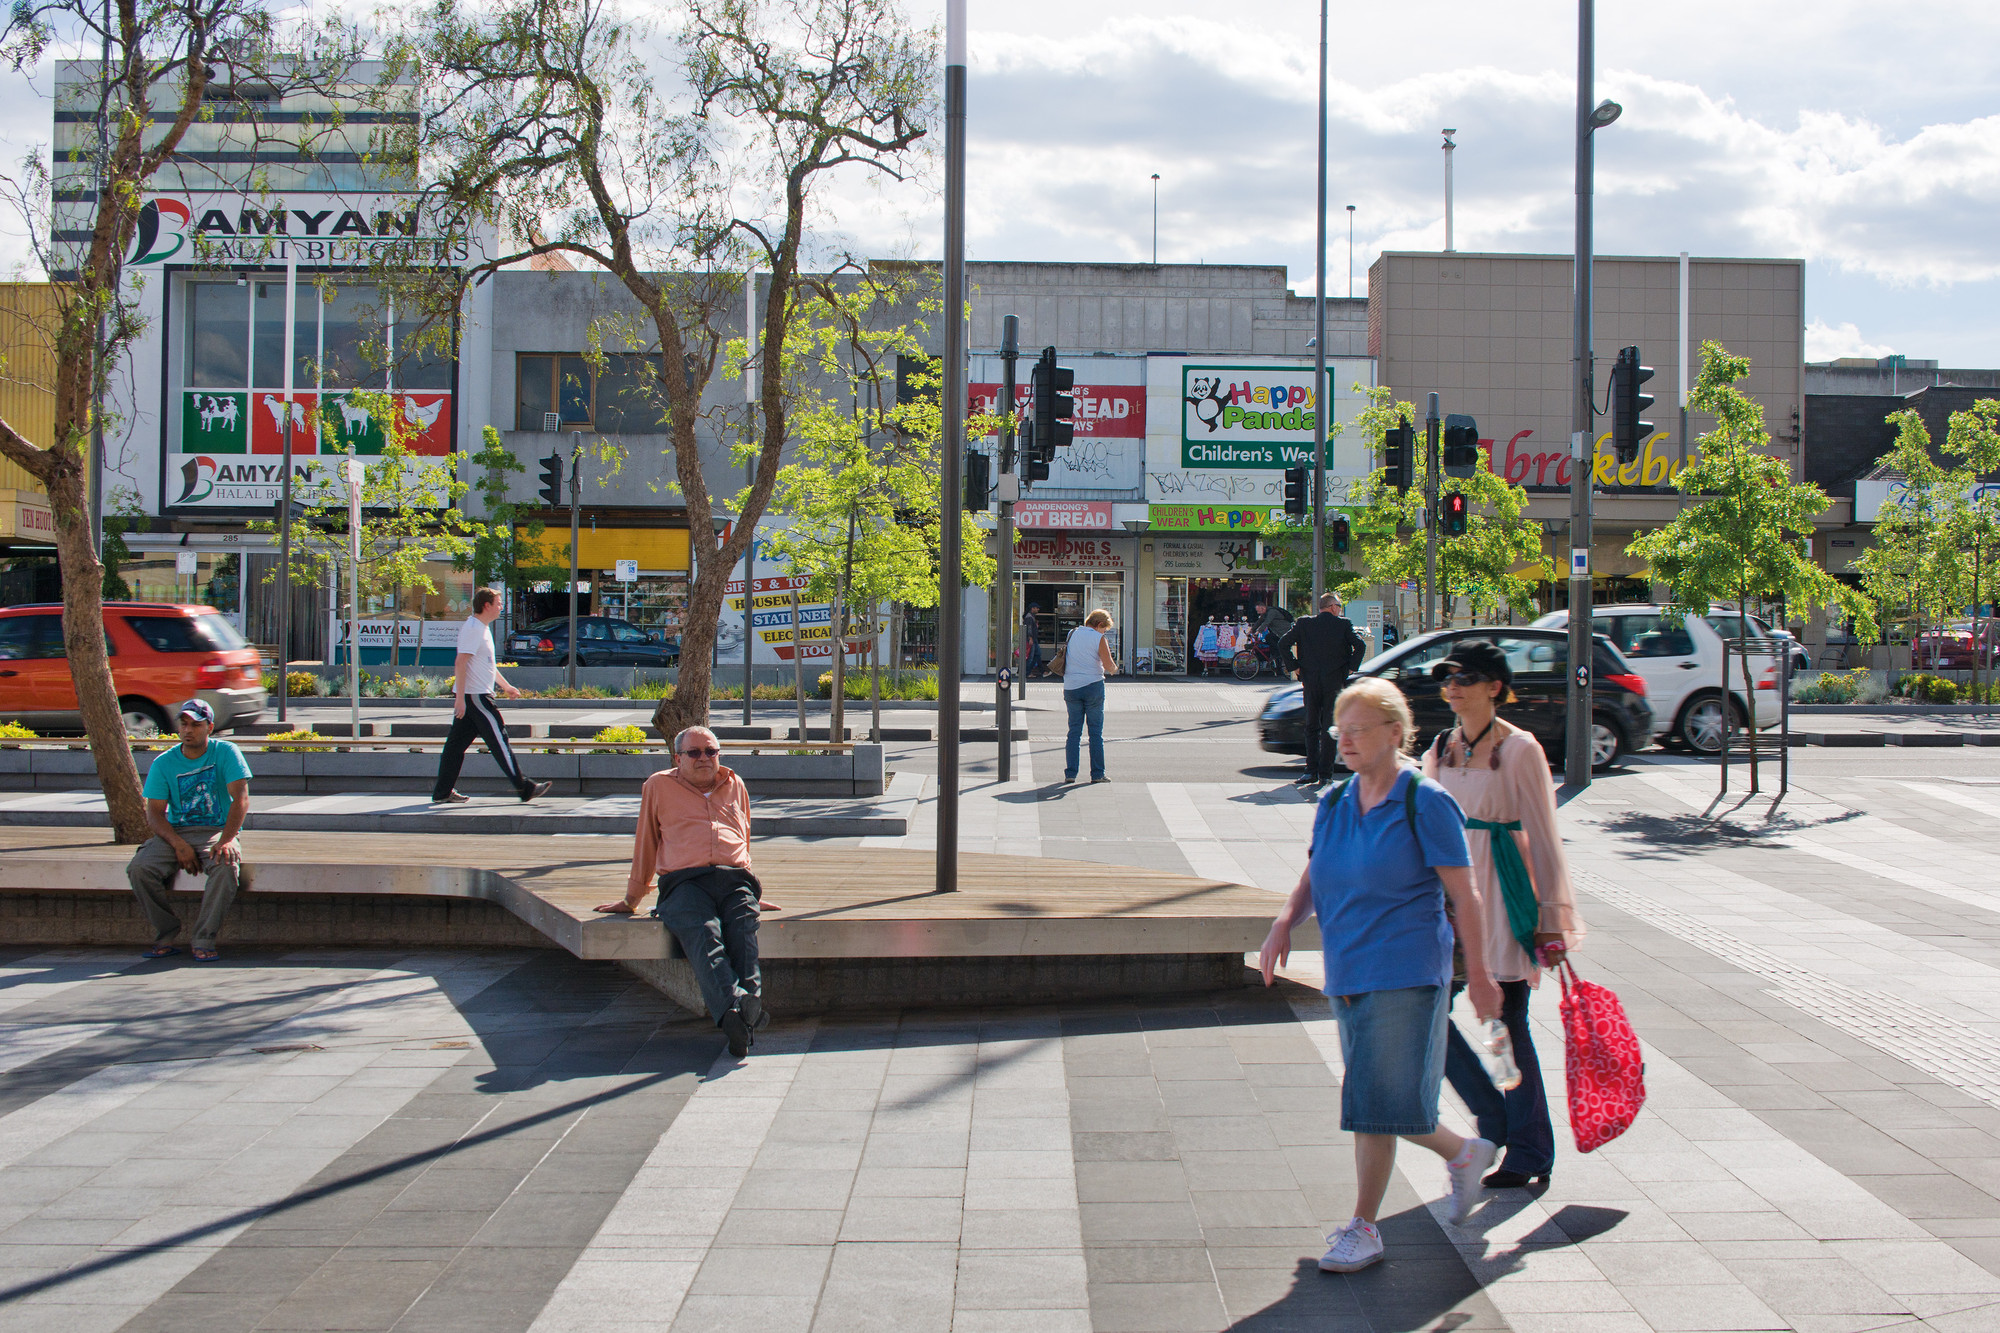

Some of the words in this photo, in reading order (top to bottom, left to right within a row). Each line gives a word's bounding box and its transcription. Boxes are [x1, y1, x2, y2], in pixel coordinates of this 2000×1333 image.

[1229, 381, 1316, 409] Happy
[1073, 398, 1129, 419] READ
[1223, 407, 1316, 430] Panda
[1073, 421, 1094, 431] AYS
[1188, 445, 1273, 462] Children's
[1280, 446, 1328, 462] Wea
[217, 488, 265, 499] HALAL
[1026, 503, 1088, 511] DANDENONG'S
[1152, 507, 1194, 517] CHILDREN'S
[1014, 511, 1043, 526] HOT
[1048, 511, 1107, 527] BREAD
[1156, 518, 1190, 527] WEAR
[1198, 507, 1266, 528] Happy
[223, 534, 239, 542] 285
[1013, 541, 1111, 555] NDENONG'S
[1239, 544, 1290, 558] Hppy
[724, 580, 762, 593] GIFS
[769, 579, 780, 589] &
[753, 609, 830, 625] STATINER
[764, 626, 831, 642] ELECRICA
[800, 643, 850, 657] TOOS
